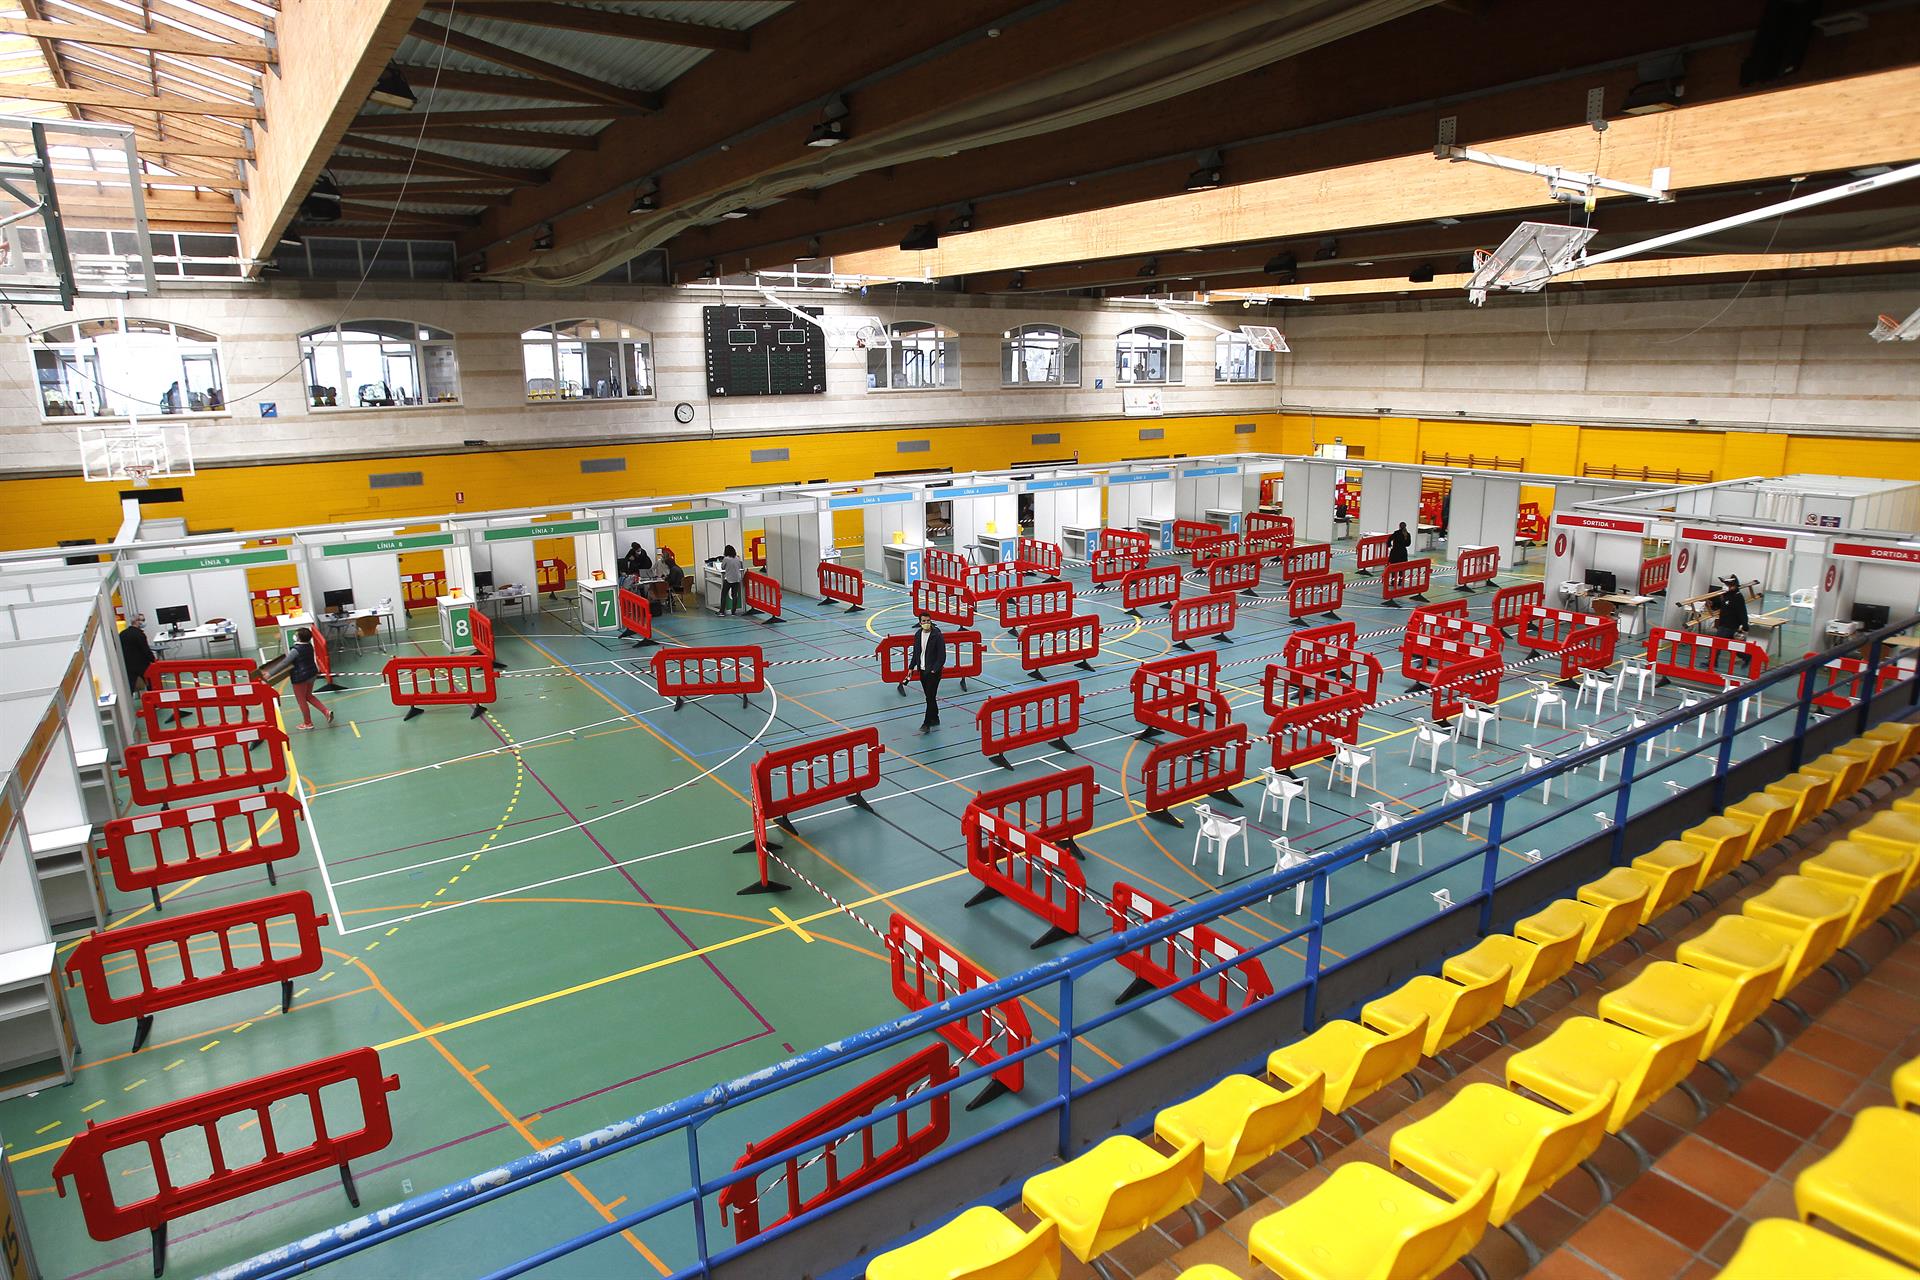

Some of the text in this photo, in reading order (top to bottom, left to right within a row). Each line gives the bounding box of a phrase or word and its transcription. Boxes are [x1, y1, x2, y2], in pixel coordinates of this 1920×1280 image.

[1582, 519, 1609, 528] SORTIDA
[532, 527, 547, 535] LÍNIA
[1163, 530, 1170, 543] 2
[1713, 533, 1745, 543] SORTIDA
[376, 541, 396, 550] LÍNIA
[1088, 540, 1096, 553] 3
[1558, 538, 1564, 553] 1
[1003, 550, 1012, 562] 4
[1870, 549, 1909, 559] SORTIDA
[200, 558, 222, 567] LÍNIA
[1679, 553, 1687, 569] 2
[910, 561, 919, 576] 5
[1826, 569, 1834, 587] 3
[600, 600, 611, 617] 7
[456, 619, 469, 637] 8
